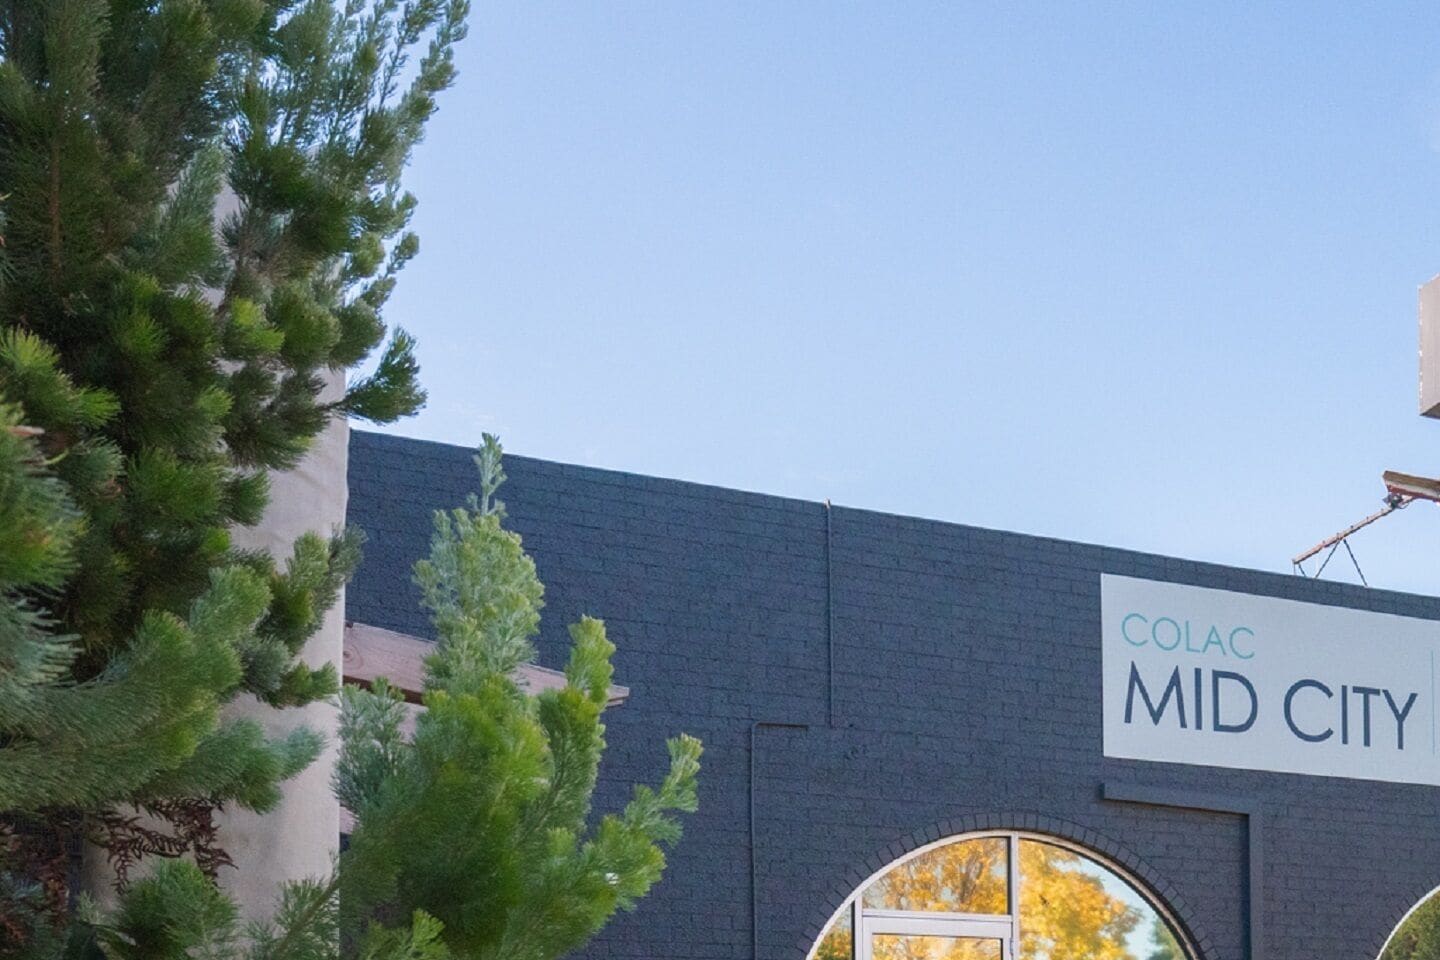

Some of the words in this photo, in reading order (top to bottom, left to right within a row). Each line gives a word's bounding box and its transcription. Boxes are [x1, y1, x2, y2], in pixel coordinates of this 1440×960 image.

[1121, 613, 1256, 660] COLAC
[1124, 660, 1258, 733] MID
[1283, 679, 1418, 750] CITY
